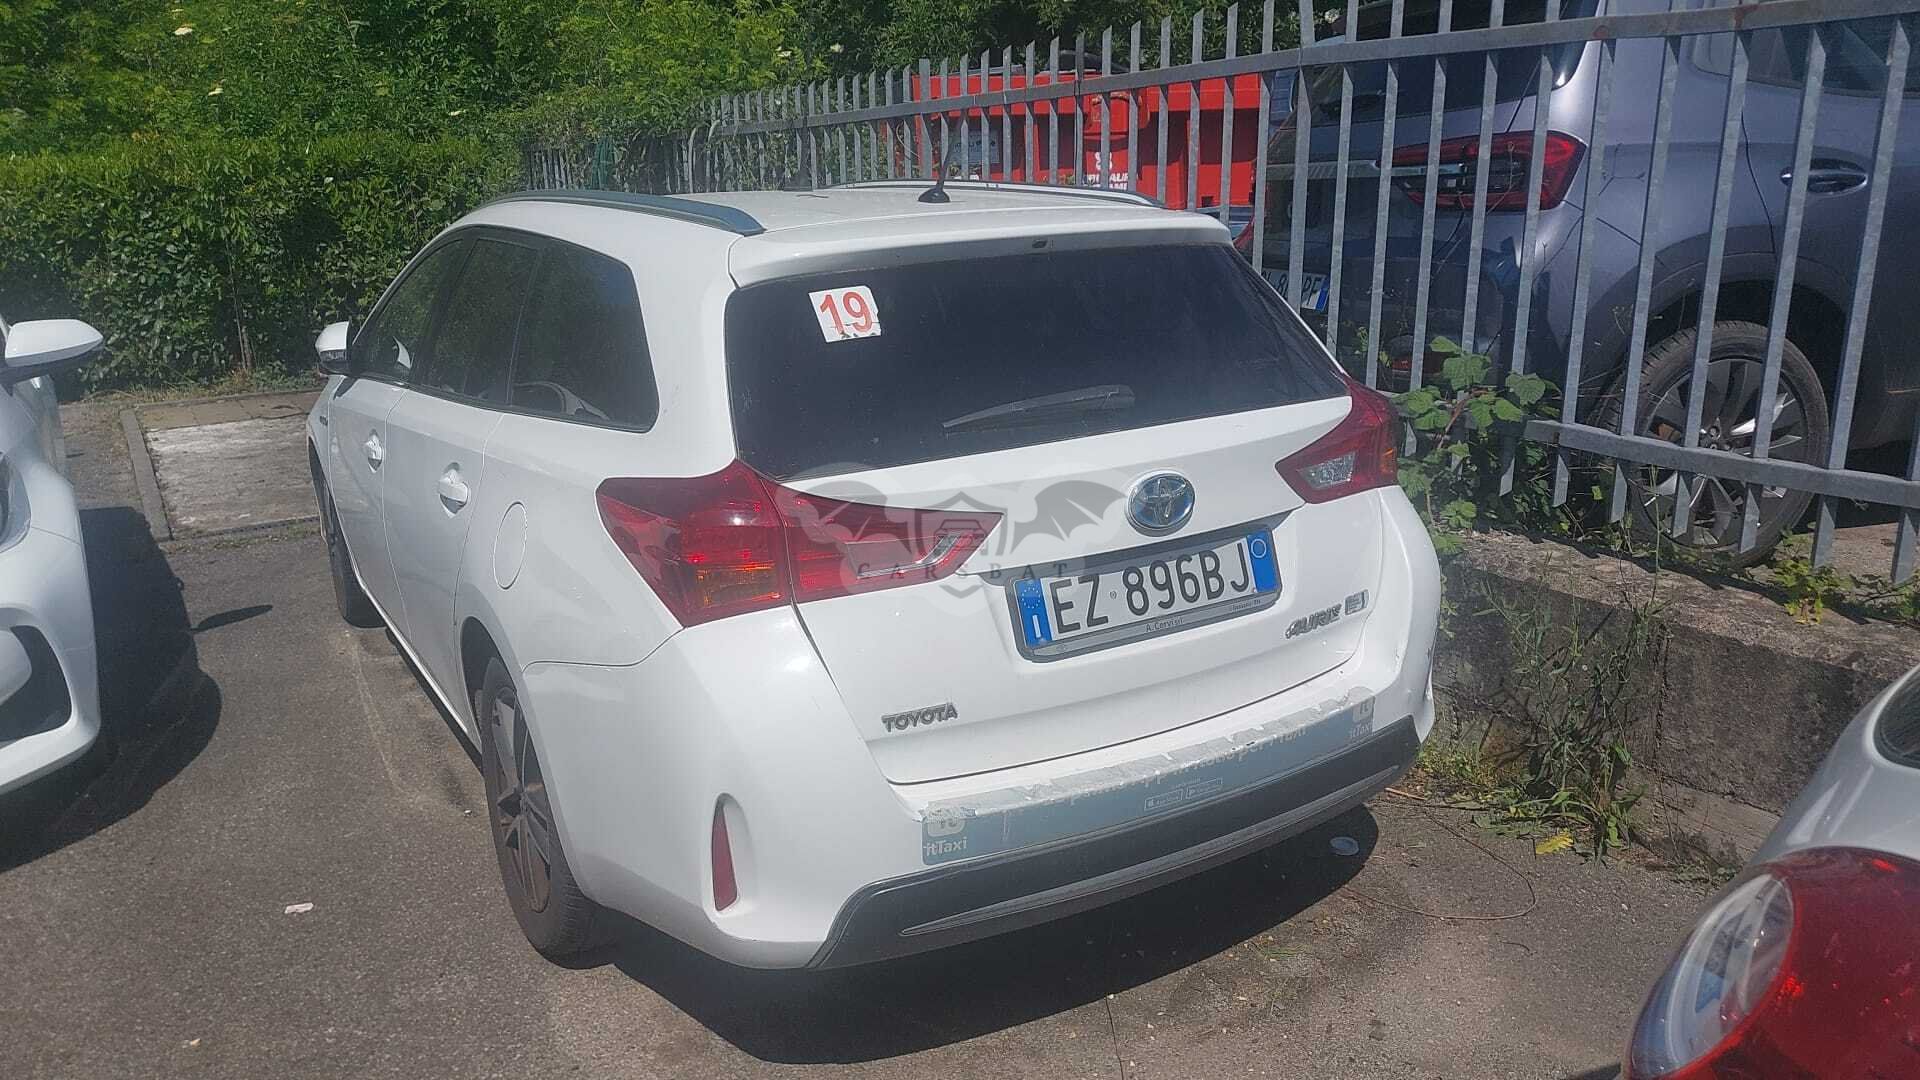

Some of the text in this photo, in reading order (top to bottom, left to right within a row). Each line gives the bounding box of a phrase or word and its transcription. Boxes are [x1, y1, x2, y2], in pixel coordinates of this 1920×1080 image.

[820, 292, 873, 335] 19
[1050, 542, 1251, 634] EZ 896BJ
[881, 702, 958, 732] TOYOTA
[926, 836, 968, 857] itTaxi
